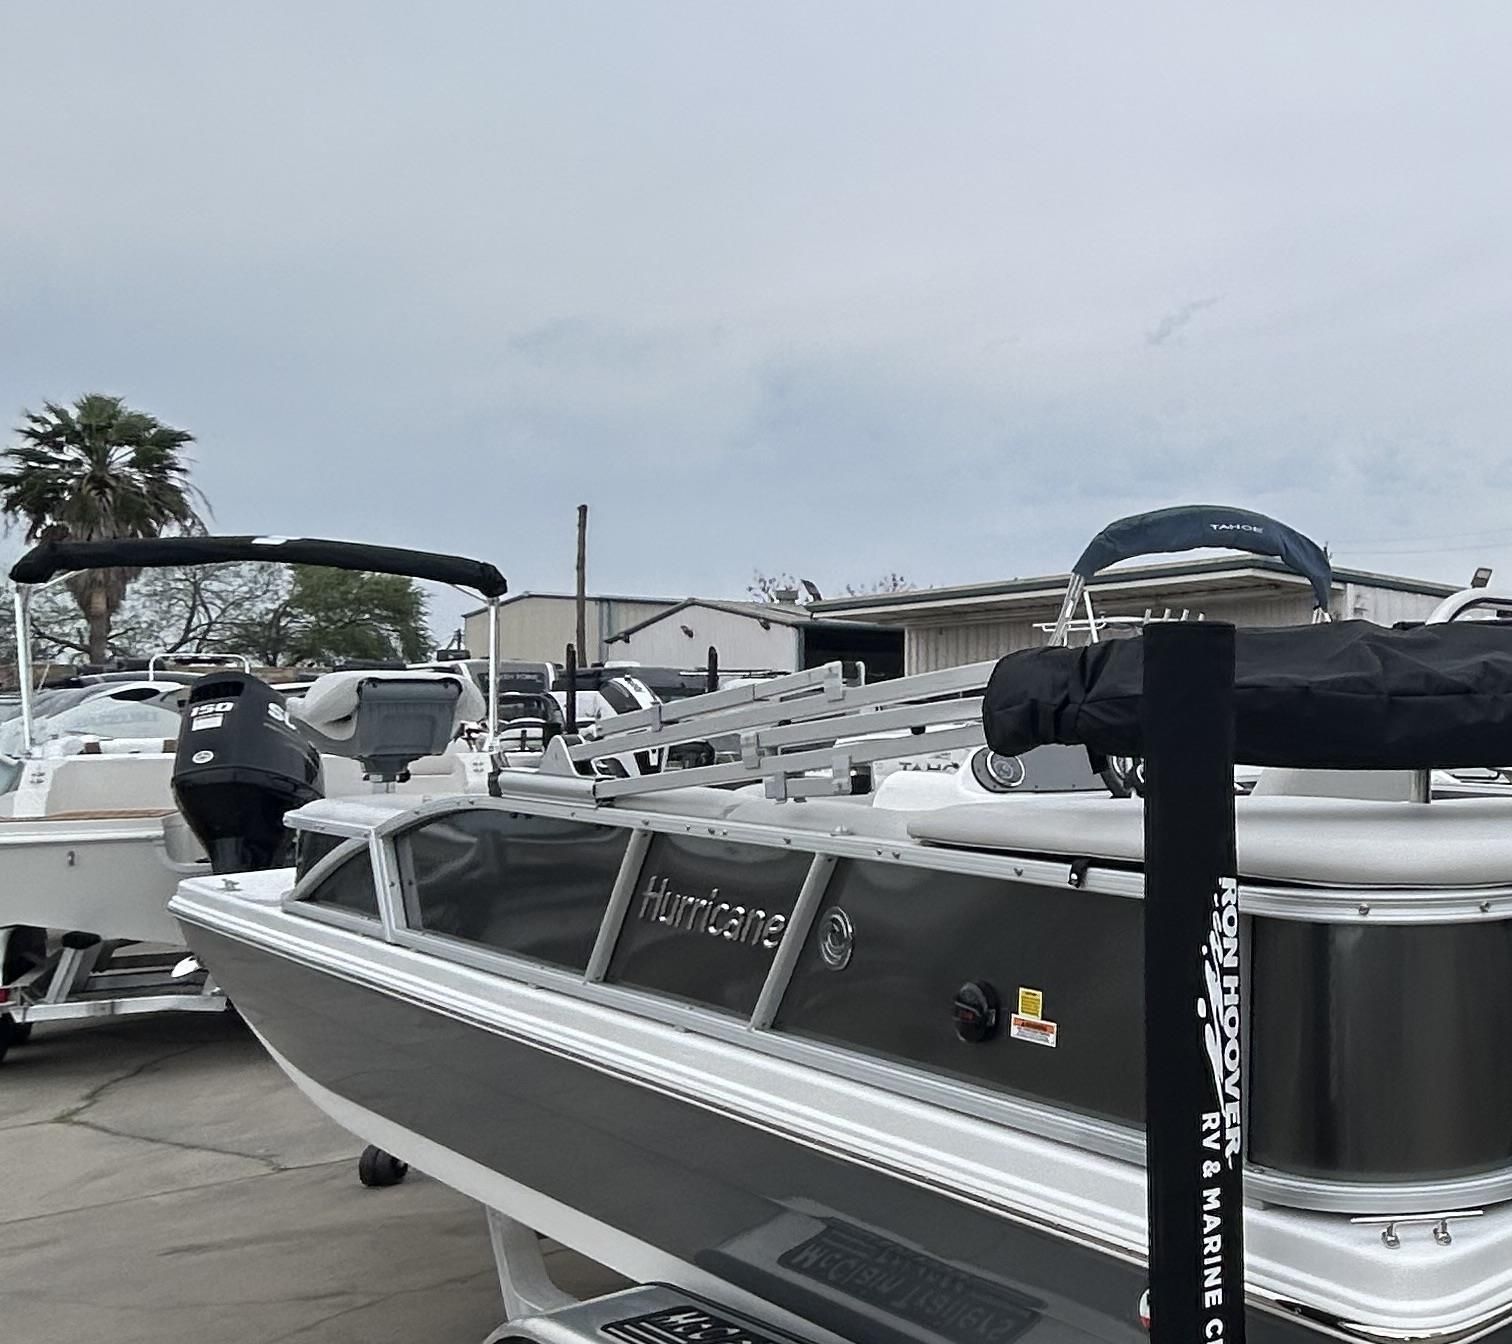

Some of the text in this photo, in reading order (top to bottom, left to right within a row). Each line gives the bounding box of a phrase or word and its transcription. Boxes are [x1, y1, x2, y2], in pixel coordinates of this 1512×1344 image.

[1210, 524, 1263, 534] TAHOE
[191, 702, 234, 717] 150
[639, 875, 785, 948] Hurricane
[1221, 877, 1241, 1168] RON HOOVER
[1202, 1113, 1221, 1150] RV
[1203, 1159, 1221, 1179] &
[1203, 1188, 1223, 1308] MARINE
